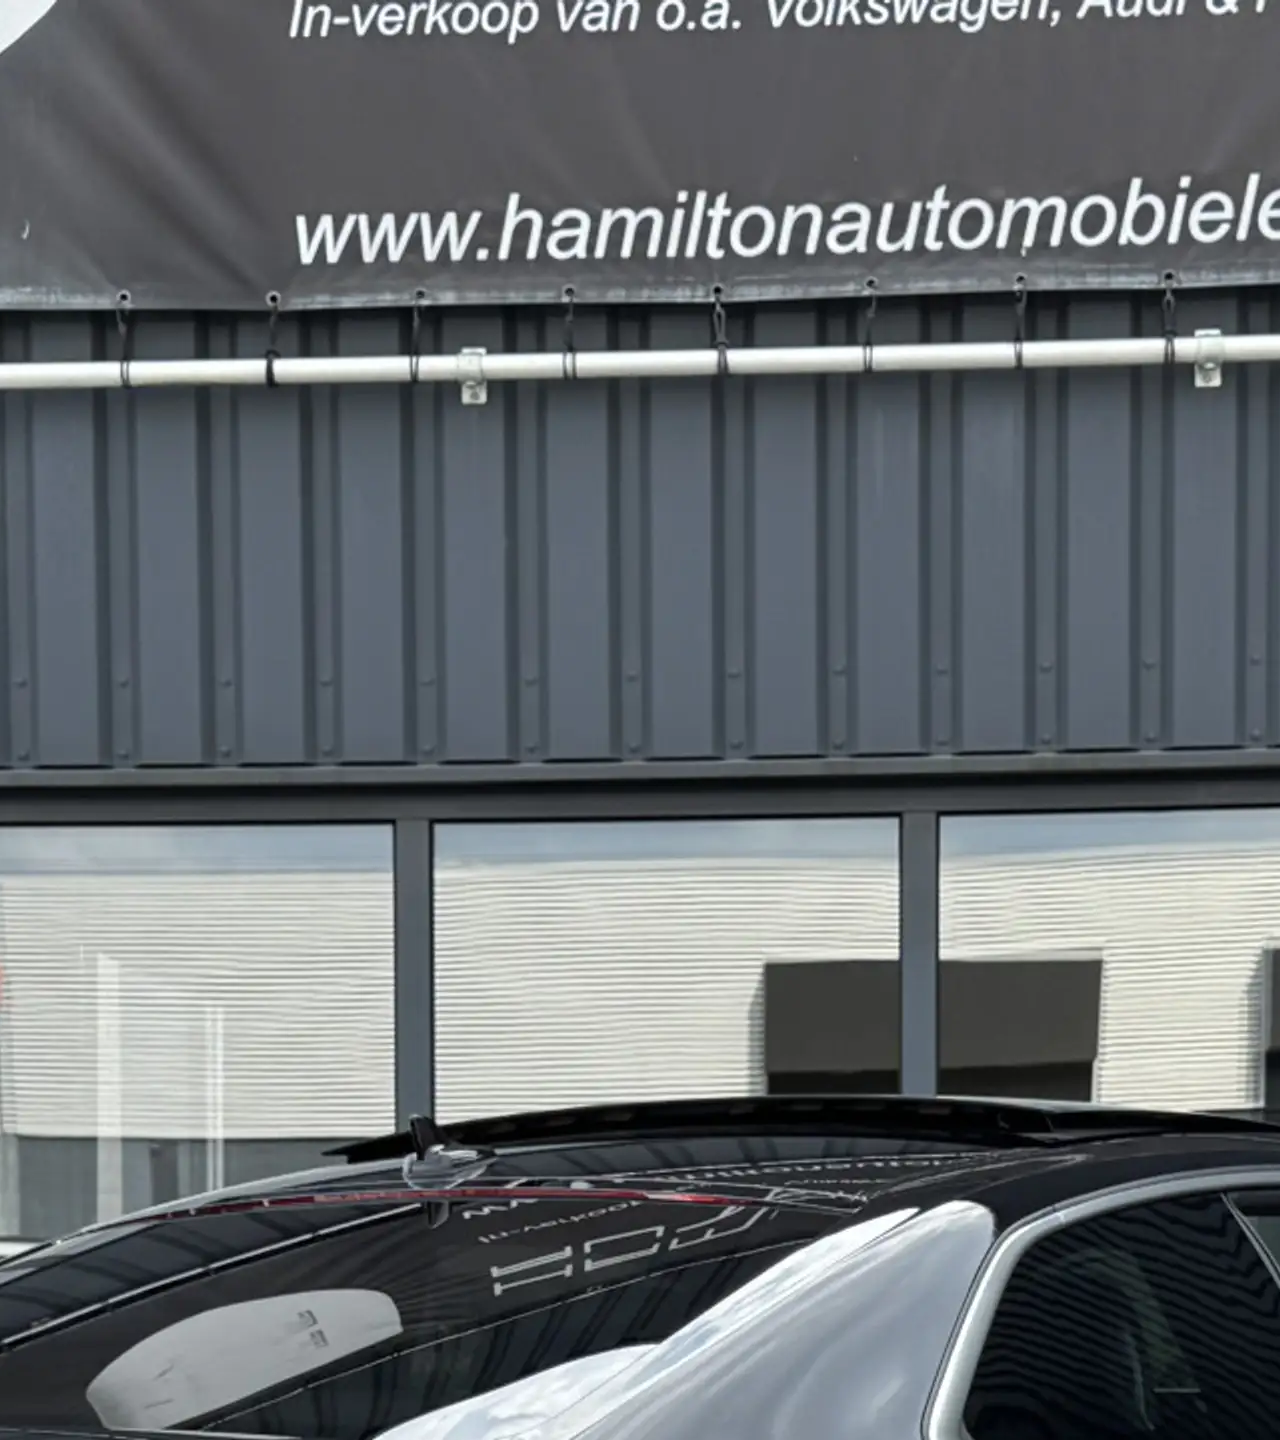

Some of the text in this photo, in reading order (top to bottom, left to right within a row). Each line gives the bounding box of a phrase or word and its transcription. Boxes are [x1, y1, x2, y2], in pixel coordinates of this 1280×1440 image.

[289, 0, 540, 45] In-verkoop
[556, 0, 641, 33] van
[656, 0, 742, 32] o.a.
